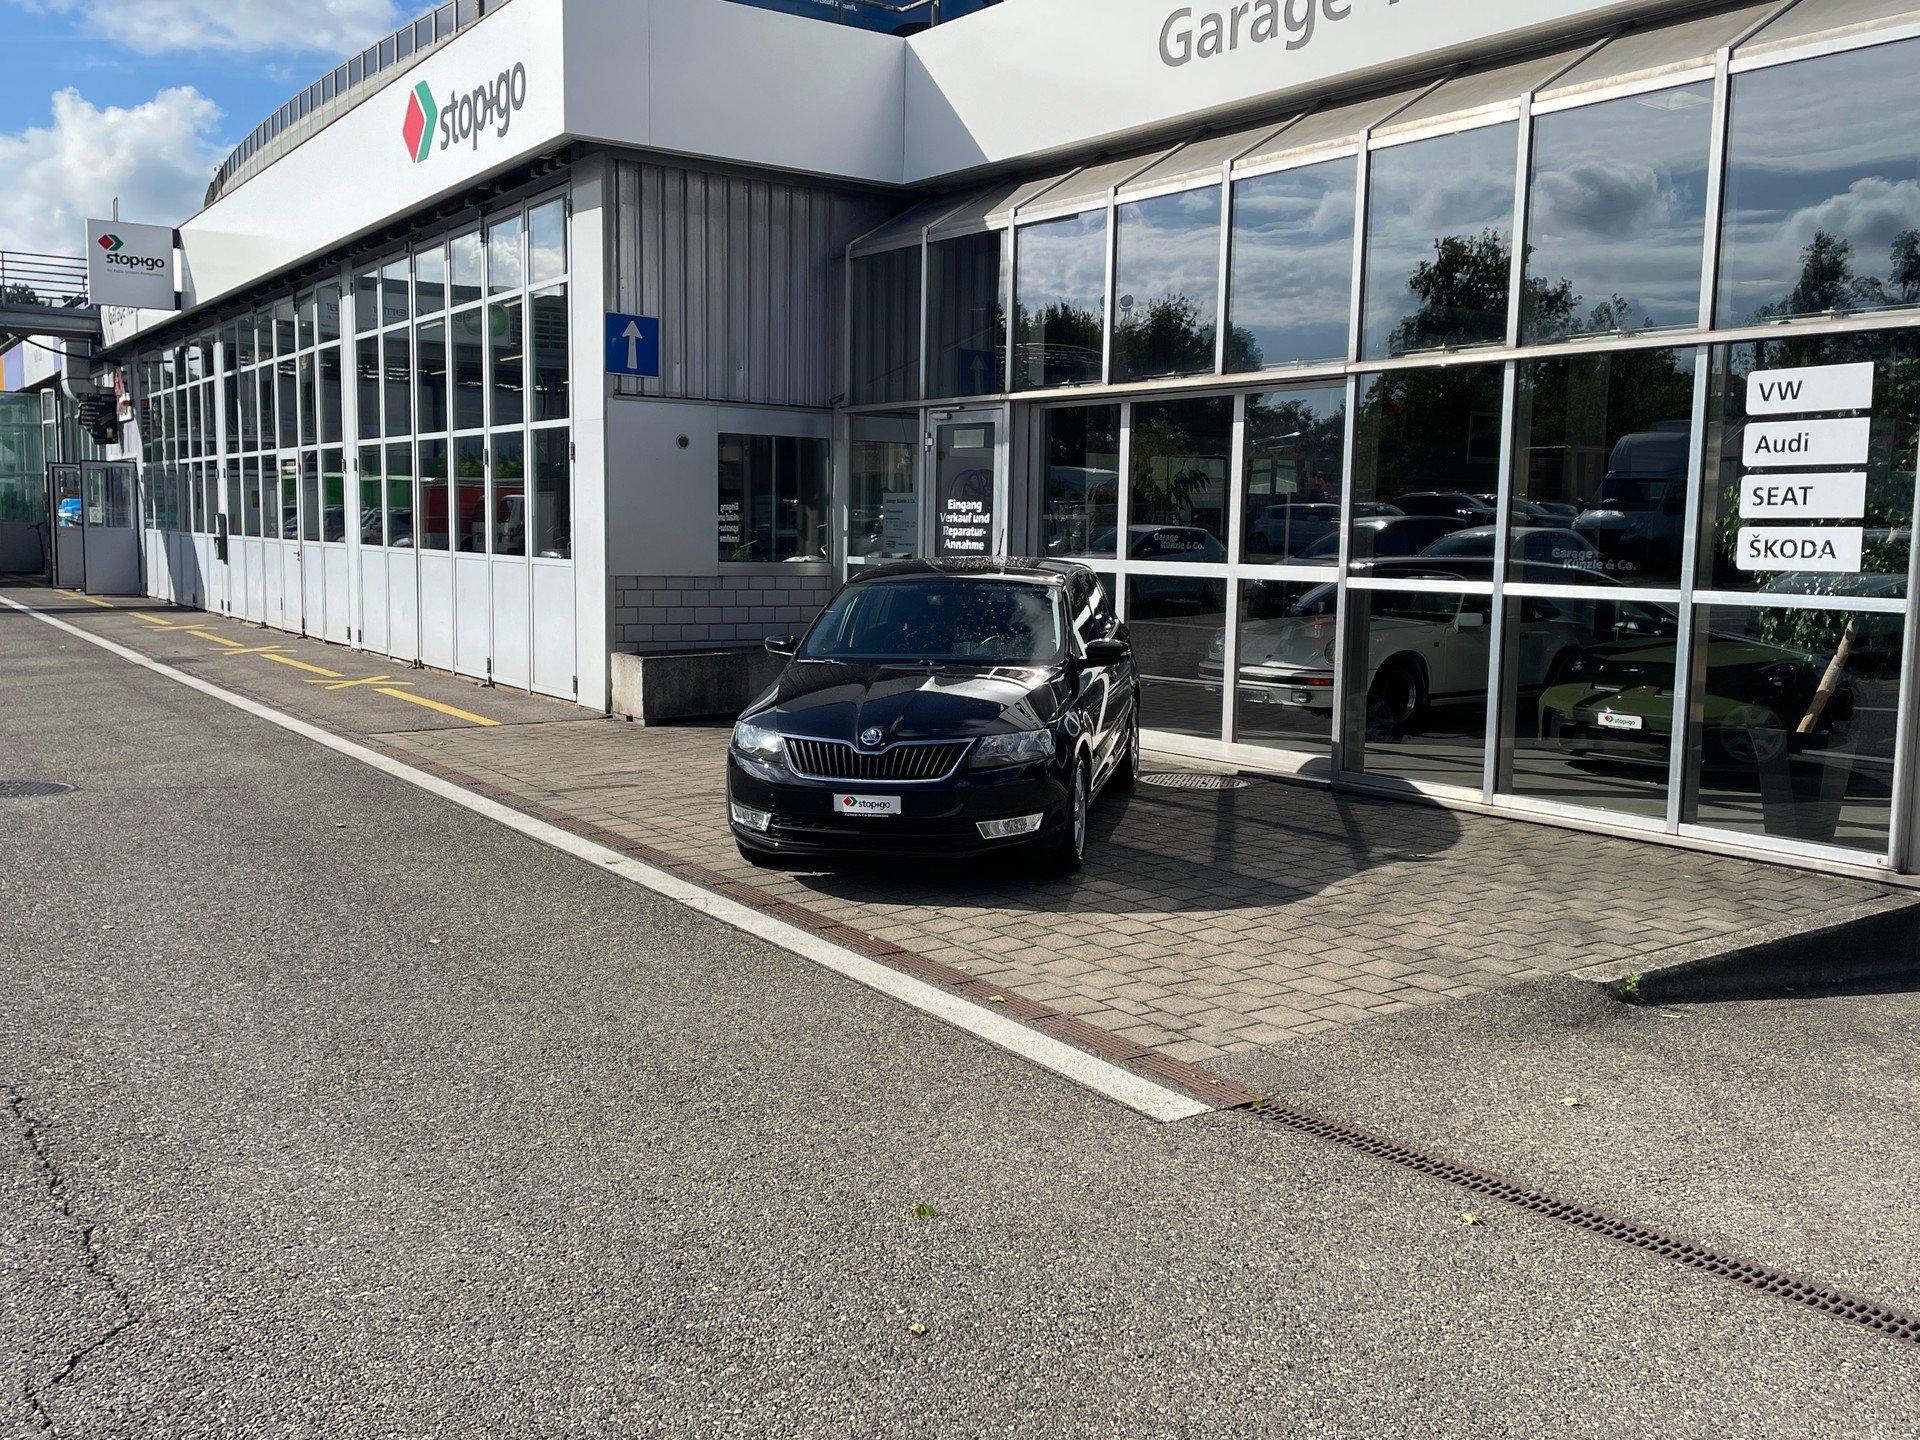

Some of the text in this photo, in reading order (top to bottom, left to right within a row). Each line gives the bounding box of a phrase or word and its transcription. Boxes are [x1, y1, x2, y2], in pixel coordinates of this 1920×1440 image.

[440, 61, 526, 151] stop+go
[106, 252, 165, 270] stop+go
[1759, 380, 1802, 402] VW
[1755, 432, 1809, 454] Audi
[1752, 486, 1813, 506] SEAT
[947, 499, 982, 513] Eingang
[940, 512, 990, 523] Verkauf und
[943, 526, 986, 539] Reparatur-
[1153, 533, 1178, 542] Garage
[944, 538, 985, 550] Annahme
[1749, 534, 1837, 559] ŠKODA
[1551, 548, 1593, 561] Garage
[1563, 559, 1637, 571] Künzle & Co.
[858, 800, 891, 810] stop+go
